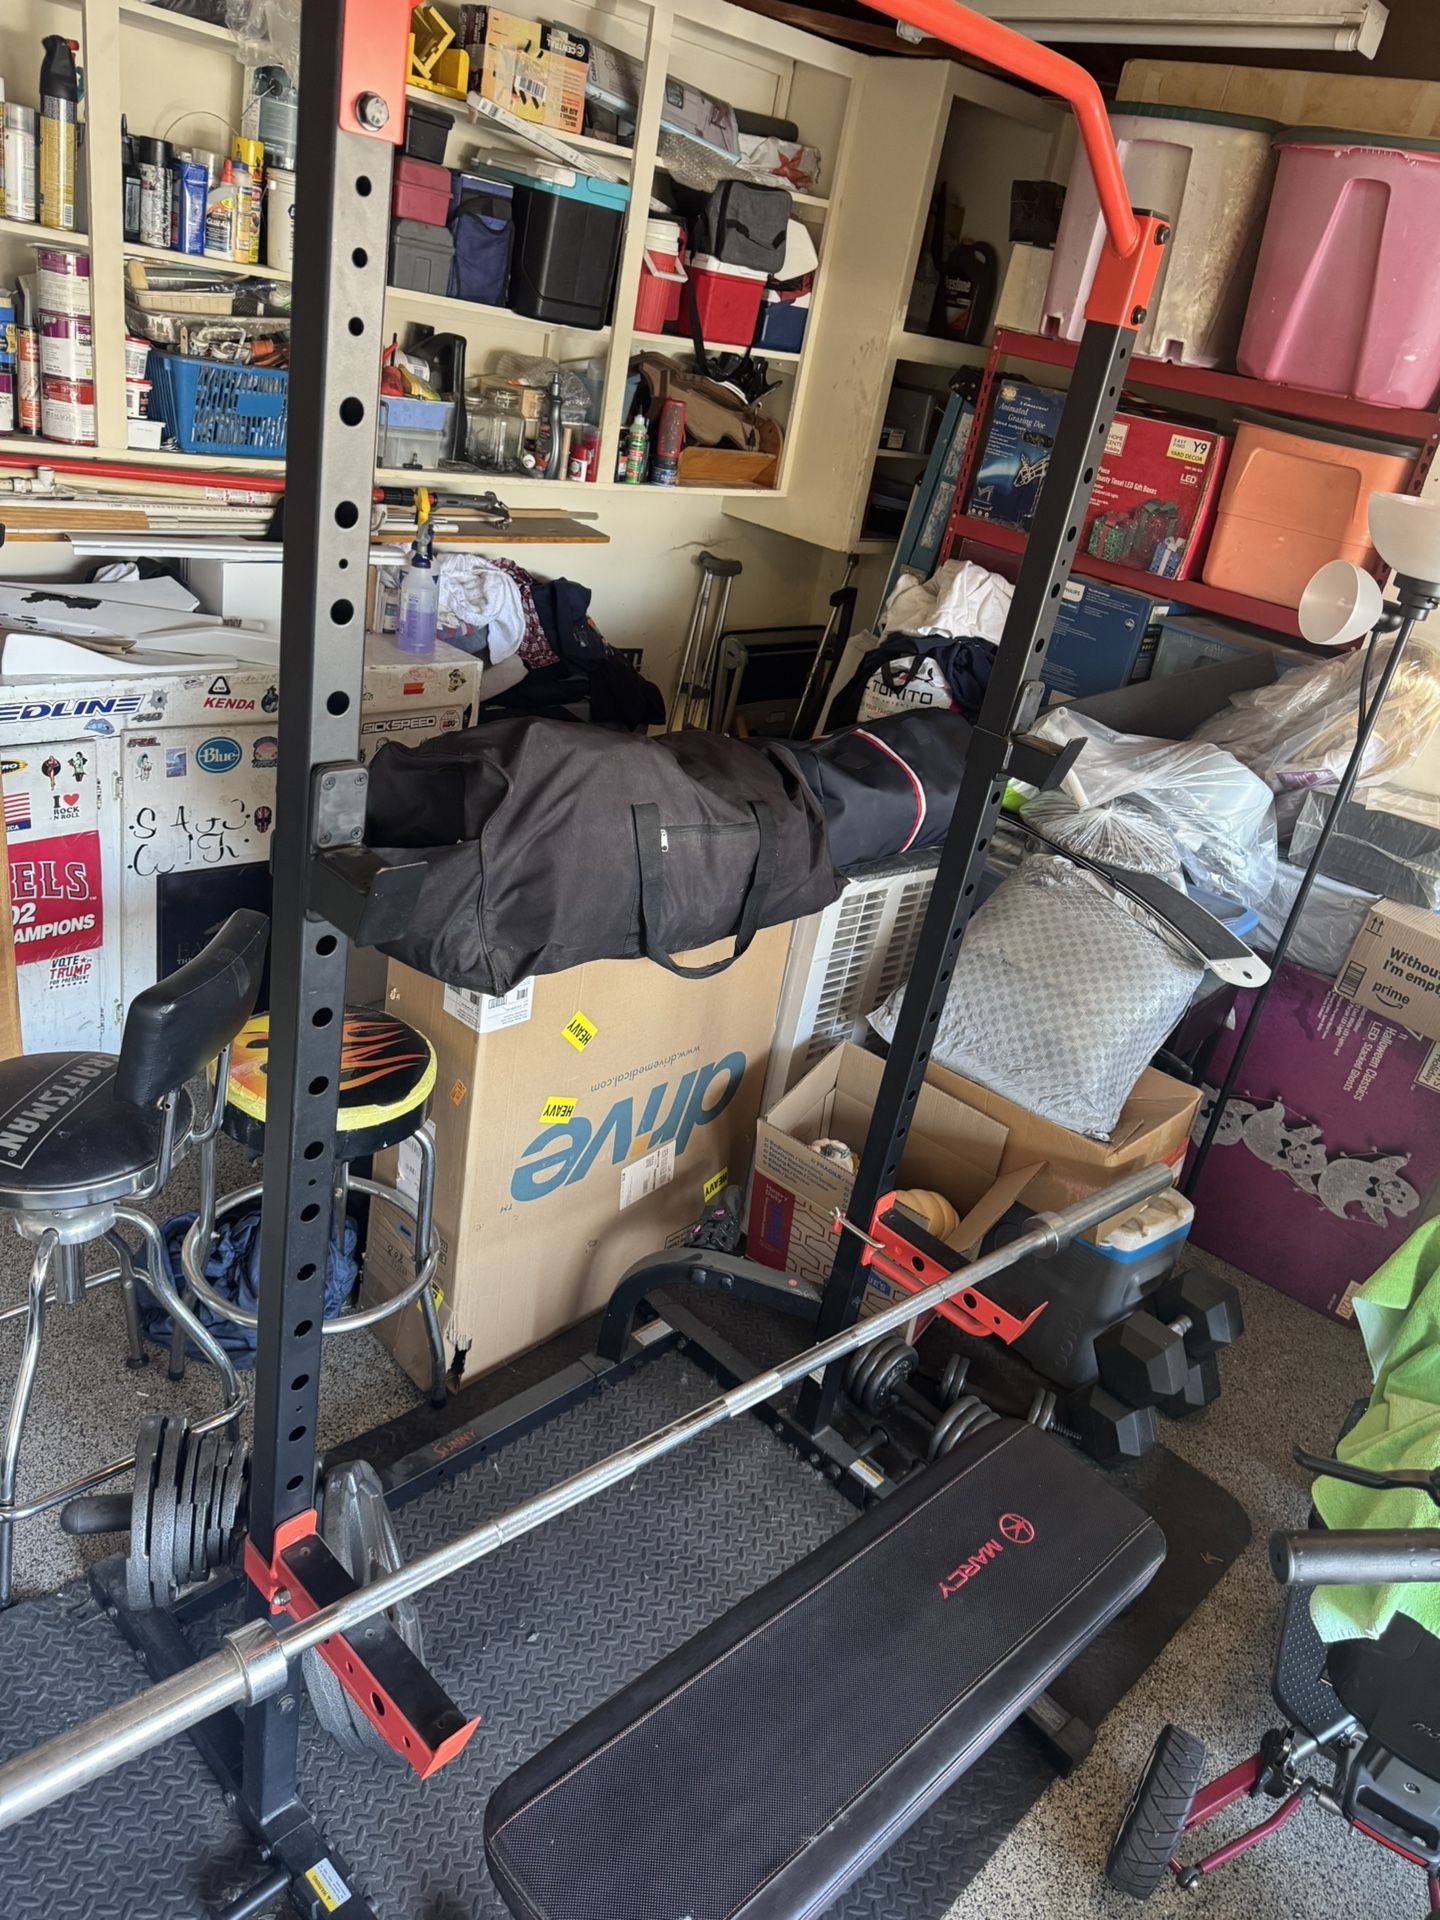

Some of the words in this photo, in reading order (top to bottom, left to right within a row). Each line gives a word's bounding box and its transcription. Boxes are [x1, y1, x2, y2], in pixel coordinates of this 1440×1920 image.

[1170, 450, 1185, 458] YARD
[1184, 453, 1203, 462] DECOR
[1193, 441, 1208, 455] Y9
[1180, 473, 1197, 485] LED
[203, 697, 256, 710] KENDA
[362, 717, 437, 734] SICKSPEED
[203, 748, 237, 763] Blue
[53, 806, 80, 816] ROCK
[60, 812, 81, 820] ROLL
[52, 955, 80, 968] VOTE
[50, 963, 92, 980] TRUMP
[61, 974, 90, 984] PRESIDENT
[1382, 958, 1404, 978] I'm
[1404, 968, 1440, 999] empt
[1372, 980, 1411, 1006] prime
[566, 1018, 593, 1046] HEAVY
[1368, 1021, 1382, 1041] LED
[1354, 1041, 1373, 1071] Stacked
[1373, 1026, 1398, 1068] Halloween
[590, 1045, 700, 1092] www.drivemedical.com
[1343, 1068, 1361, 1092] Ghosts
[1353, 1069, 1378, 1102] Classics
[542, 1103, 575, 1118] HEAVY
[511, 1051, 746, 1202] drive
[704, 1170, 728, 1196] HEAVY
[939, 1538, 1004, 1600] MARCY
